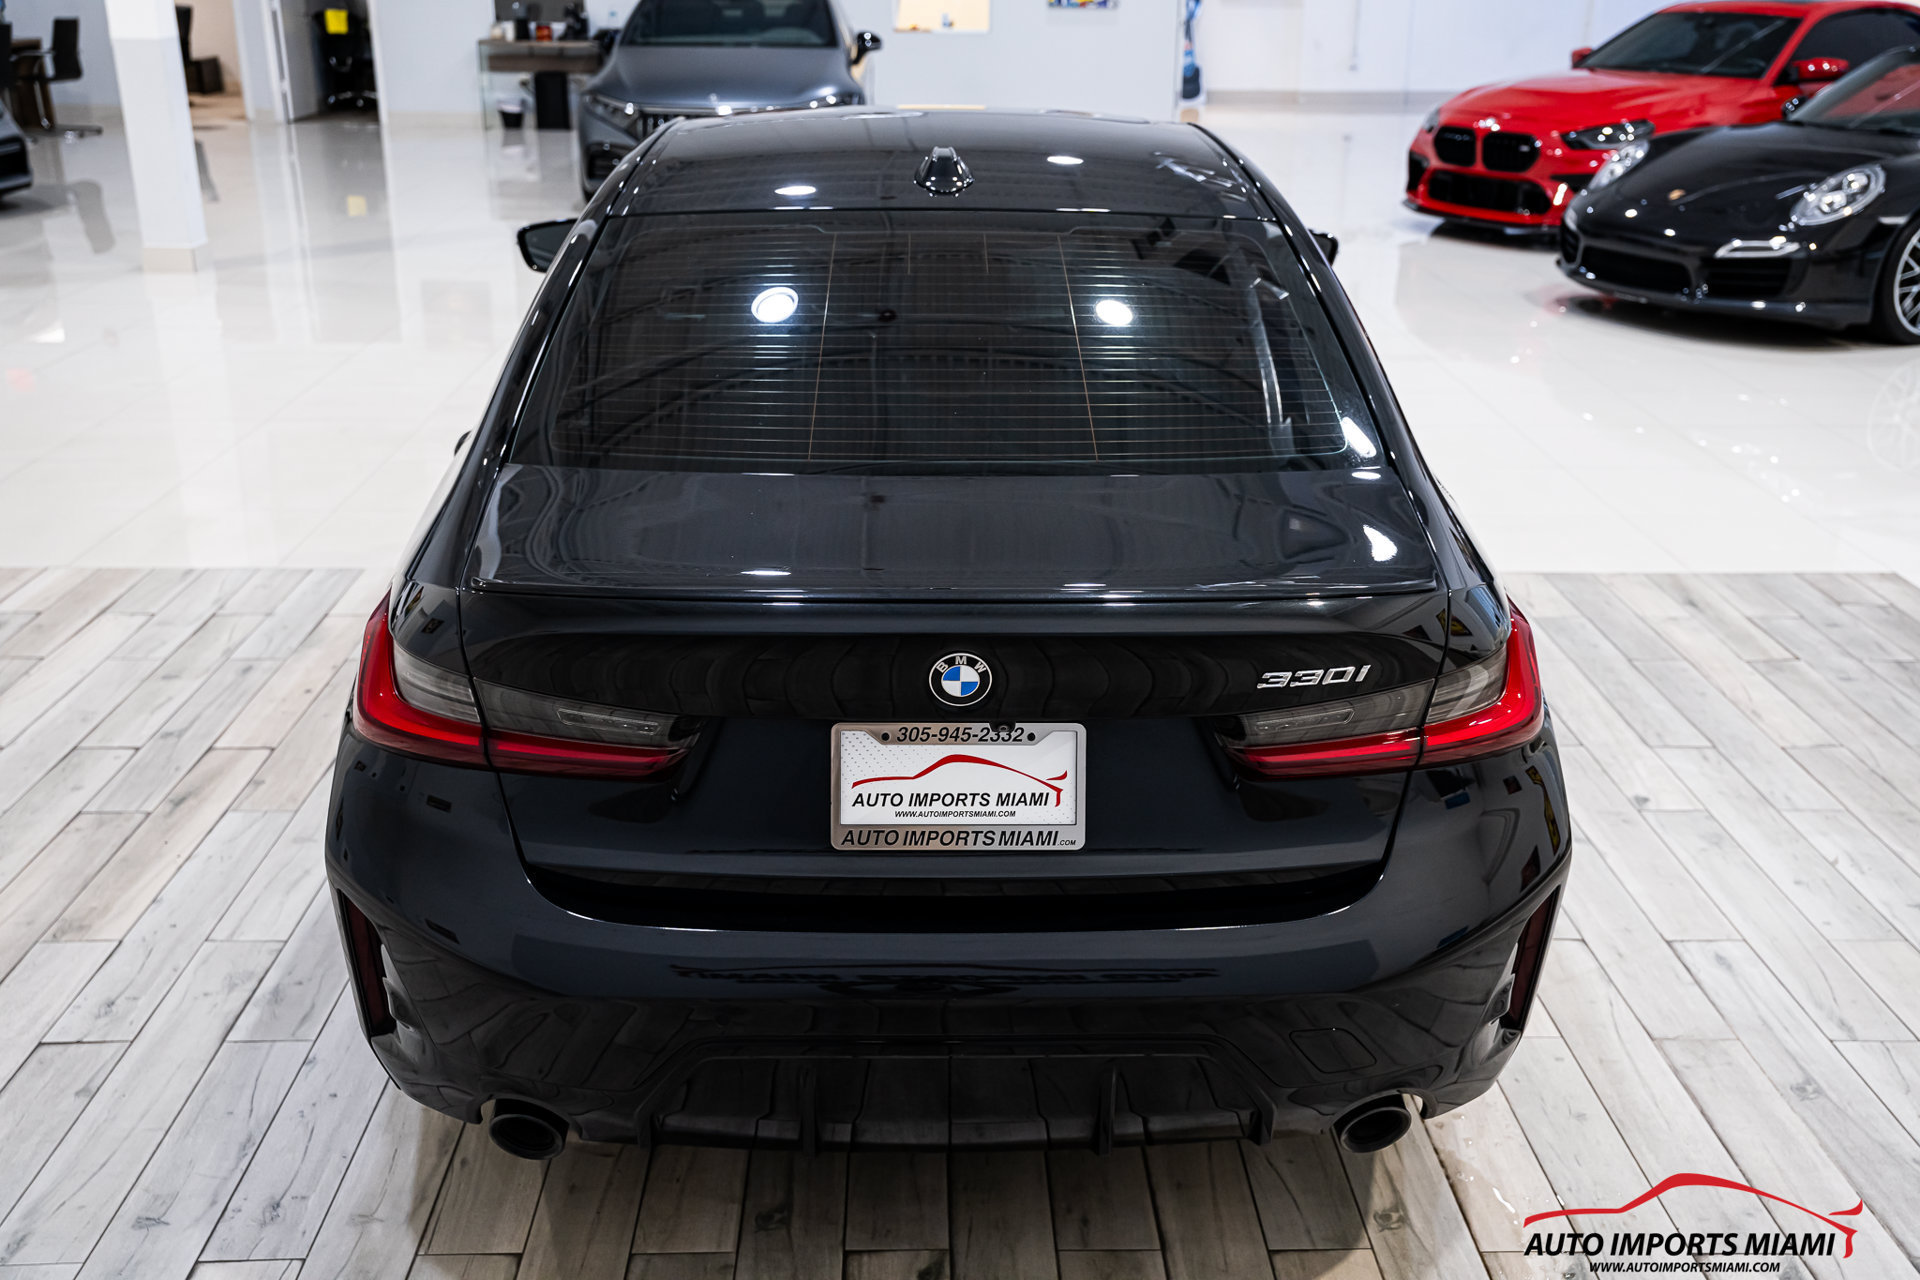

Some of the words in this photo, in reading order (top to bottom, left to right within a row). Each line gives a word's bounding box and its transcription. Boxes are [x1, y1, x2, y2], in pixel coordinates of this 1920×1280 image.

[935, 655, 987, 674] BMW
[896, 726, 1025, 742] 305-945-2332
[852, 792, 904, 807] AUTO
[908, 792, 991, 807] IMPORTS
[995, 792, 1049, 807] MIAMI
[894, 810, 1016, 818] WWW.AUTOIMPORTSMIAMI.COM
[841, 830, 900, 846] AUTO
